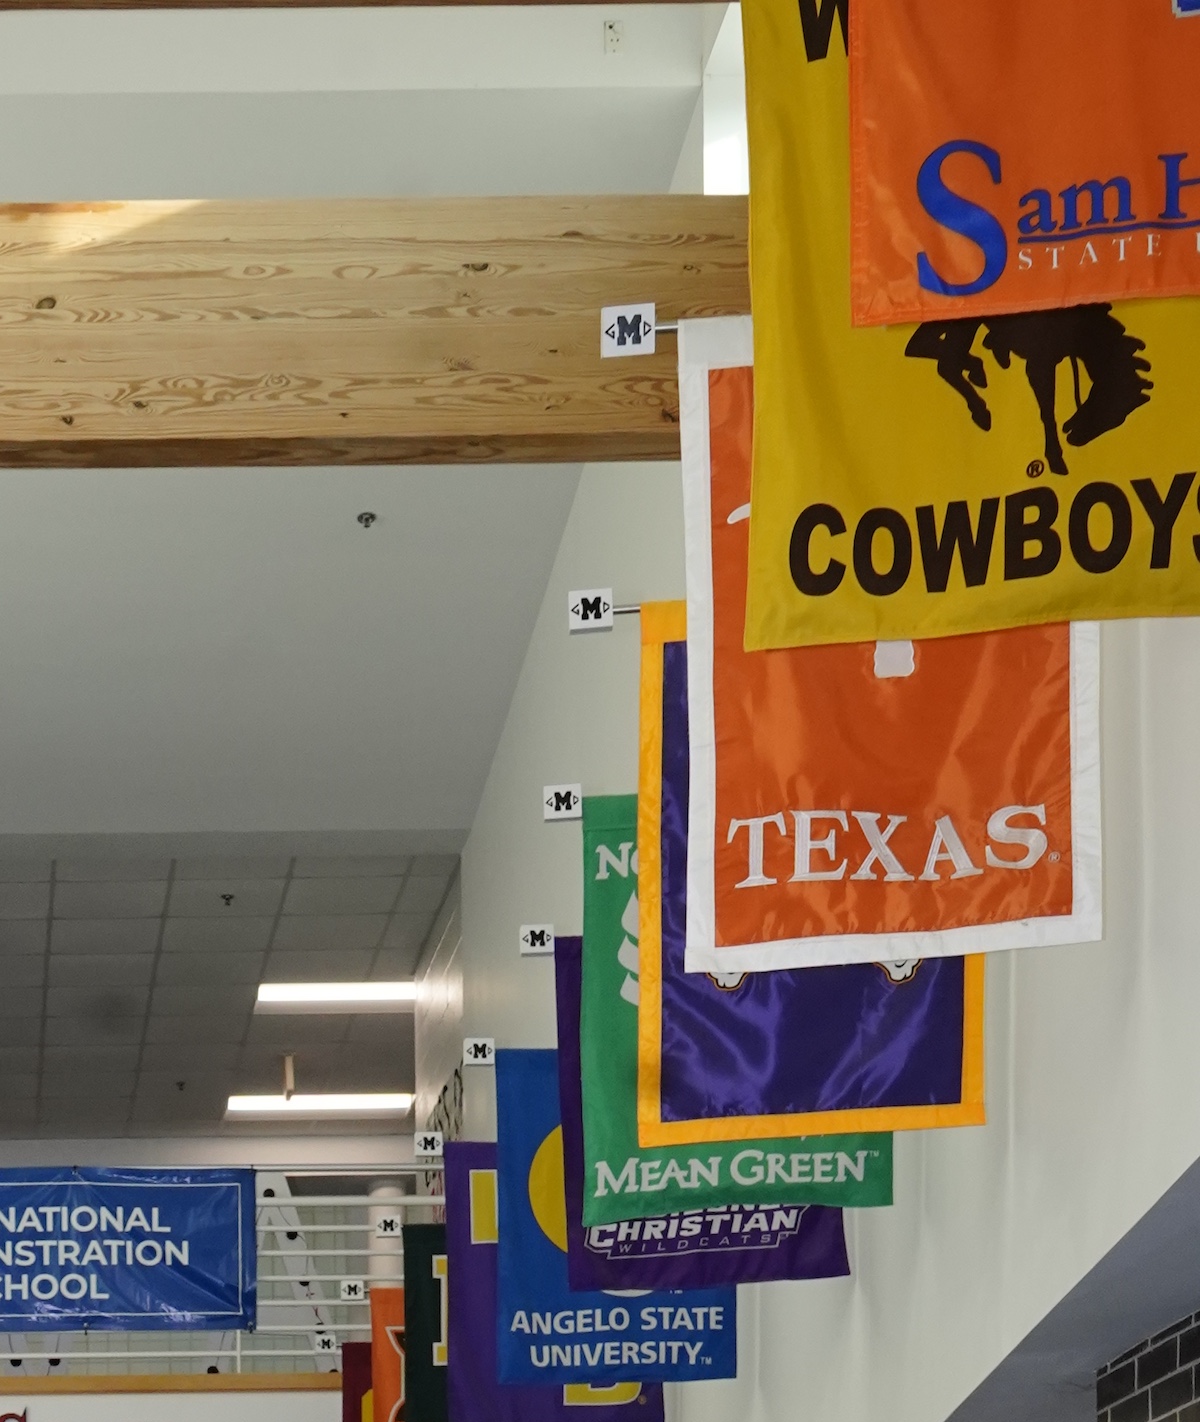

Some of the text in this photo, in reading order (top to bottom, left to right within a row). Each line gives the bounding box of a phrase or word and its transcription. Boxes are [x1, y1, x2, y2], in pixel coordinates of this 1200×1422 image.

[916, 139, 1135, 296] Sam
[1017, 233, 1162, 271] STATE
[789, 472, 1200, 597] COWBOY
[726, 804, 1049, 889] TEXAS
[594, 1149, 869, 1198] MEAN GREEN
[588, 1208, 800, 1249] CHRISTIAN
[618, 1232, 772, 1254] WILDCATS
[510, 1306, 724, 1334] ANGELO STATE
[530, 1341, 704, 1368] UNIVERSITY
